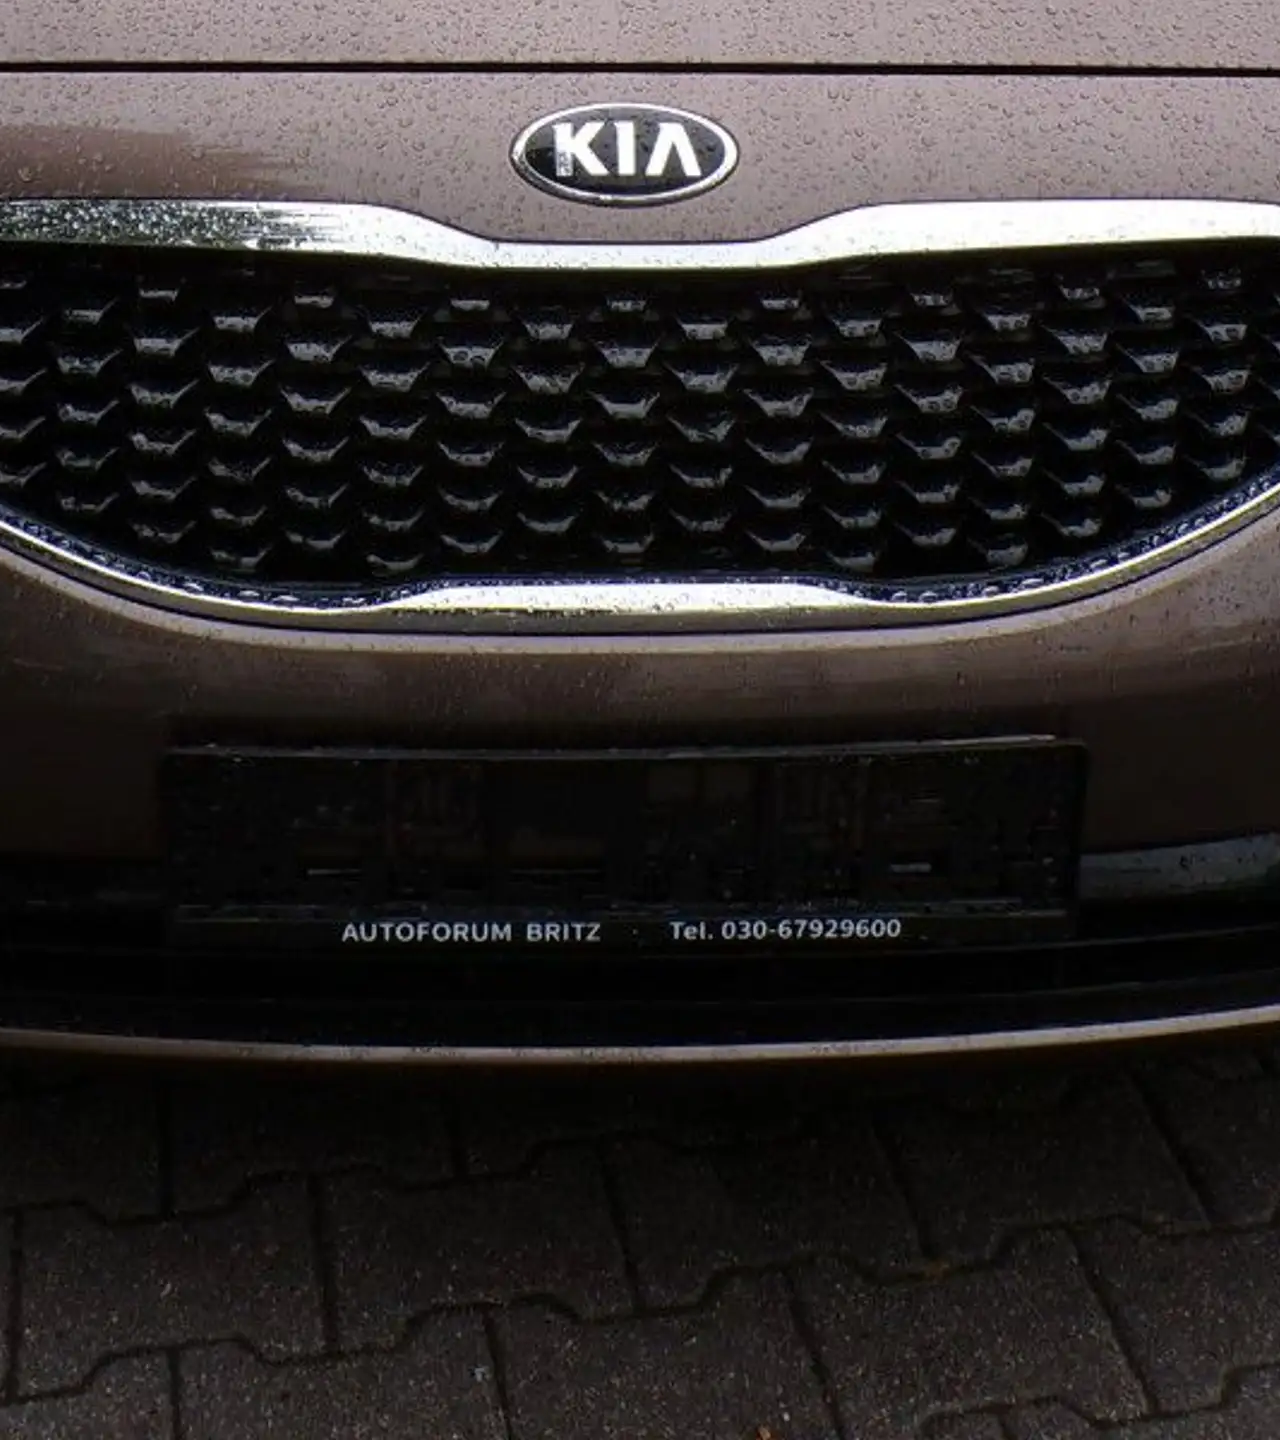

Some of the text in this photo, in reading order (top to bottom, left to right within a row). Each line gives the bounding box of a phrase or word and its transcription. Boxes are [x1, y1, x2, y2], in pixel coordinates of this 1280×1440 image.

[552, 120, 703, 178] KIA
[341, 918, 902, 943] AUTOFORUM BRITZ Tel. 030-67929600
